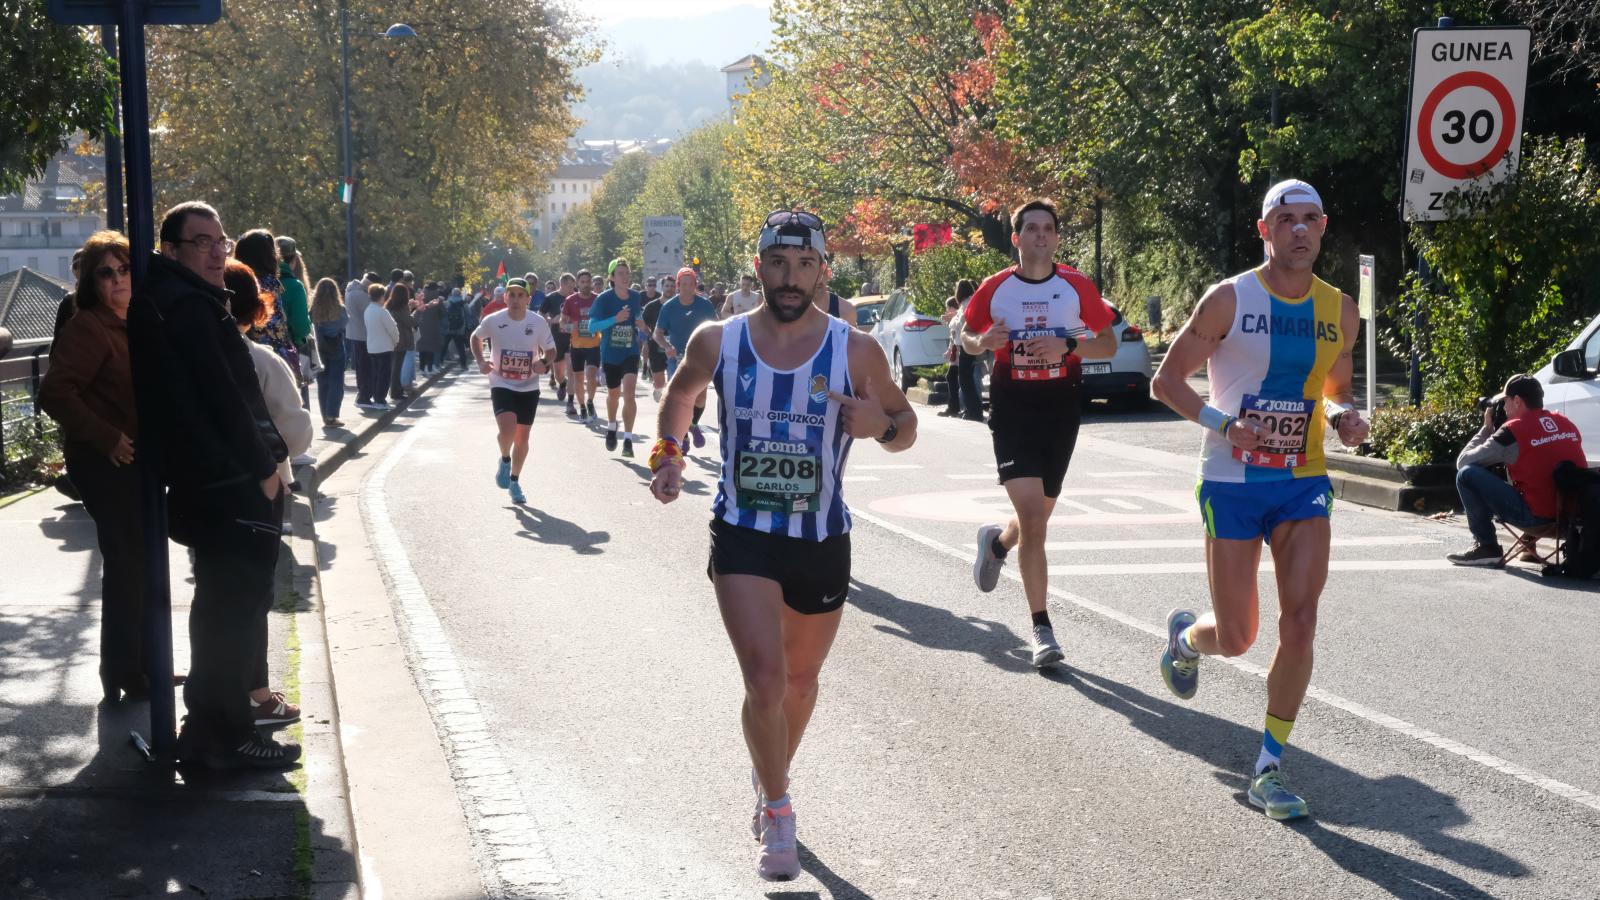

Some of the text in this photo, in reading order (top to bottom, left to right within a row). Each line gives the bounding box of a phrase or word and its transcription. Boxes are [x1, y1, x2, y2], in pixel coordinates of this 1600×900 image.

[1431, 41, 1514, 62] GUNEA
[1441, 109, 1495, 145] 30
[1241, 314, 1338, 342] CANARIAS
[503, 357, 529, 367] 3178
[767, 411, 826, 426] GIPUZKOA
[1278, 439, 1301, 447] YAIZA
[741, 456, 814, 479] 2208
[756, 482, 800, 491] CARLOS
